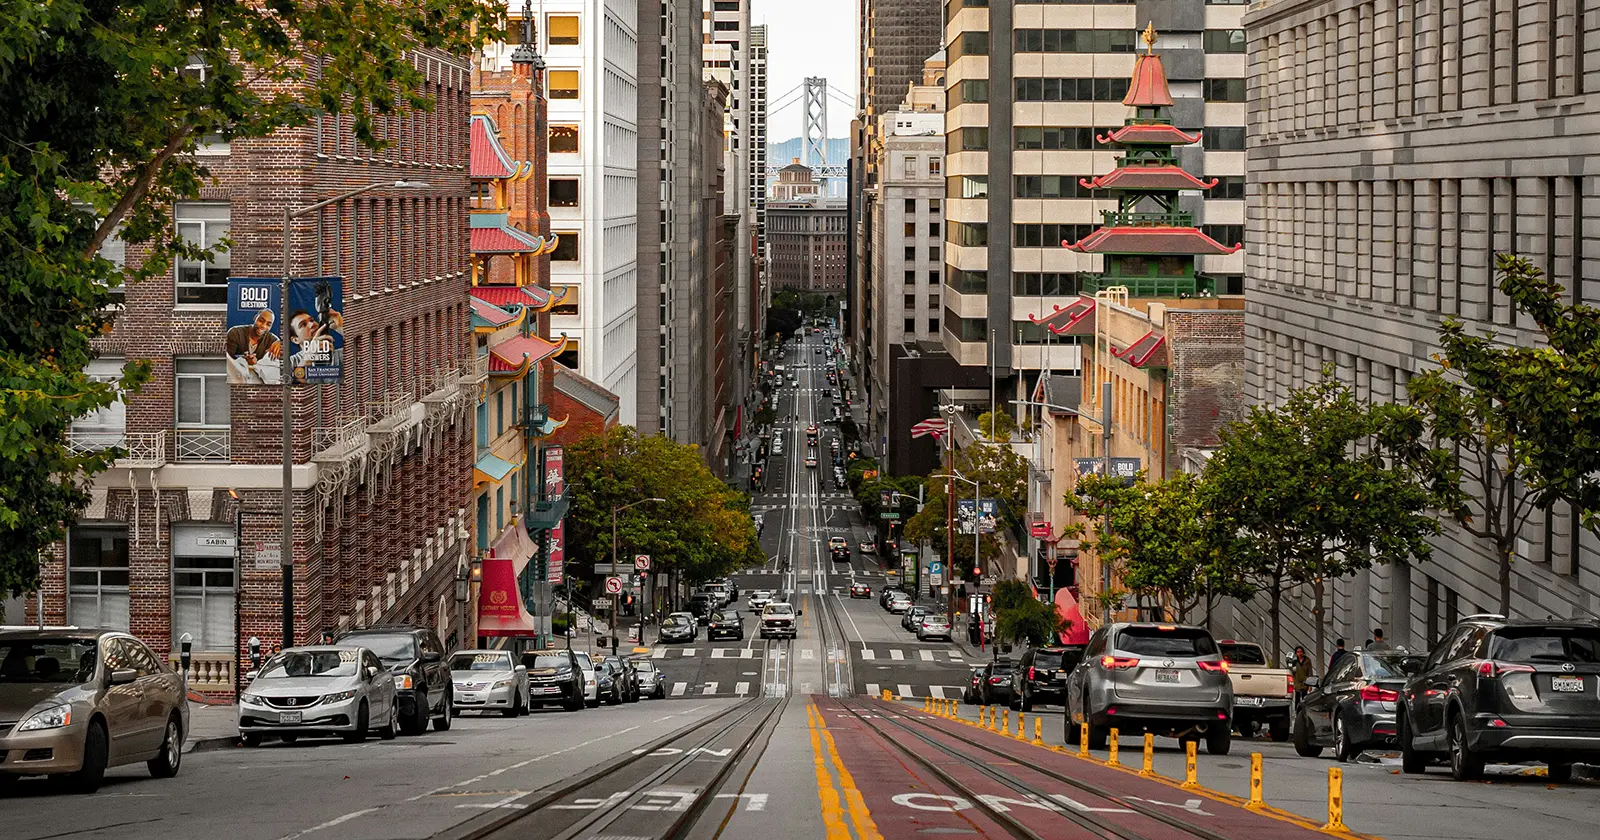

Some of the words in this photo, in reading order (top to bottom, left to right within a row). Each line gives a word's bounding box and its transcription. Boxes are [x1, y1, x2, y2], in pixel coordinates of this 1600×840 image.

[241, 287, 268, 300] BOLD
[303, 340, 330, 353] BOLD
[1117, 463, 1134, 471] BOLD
